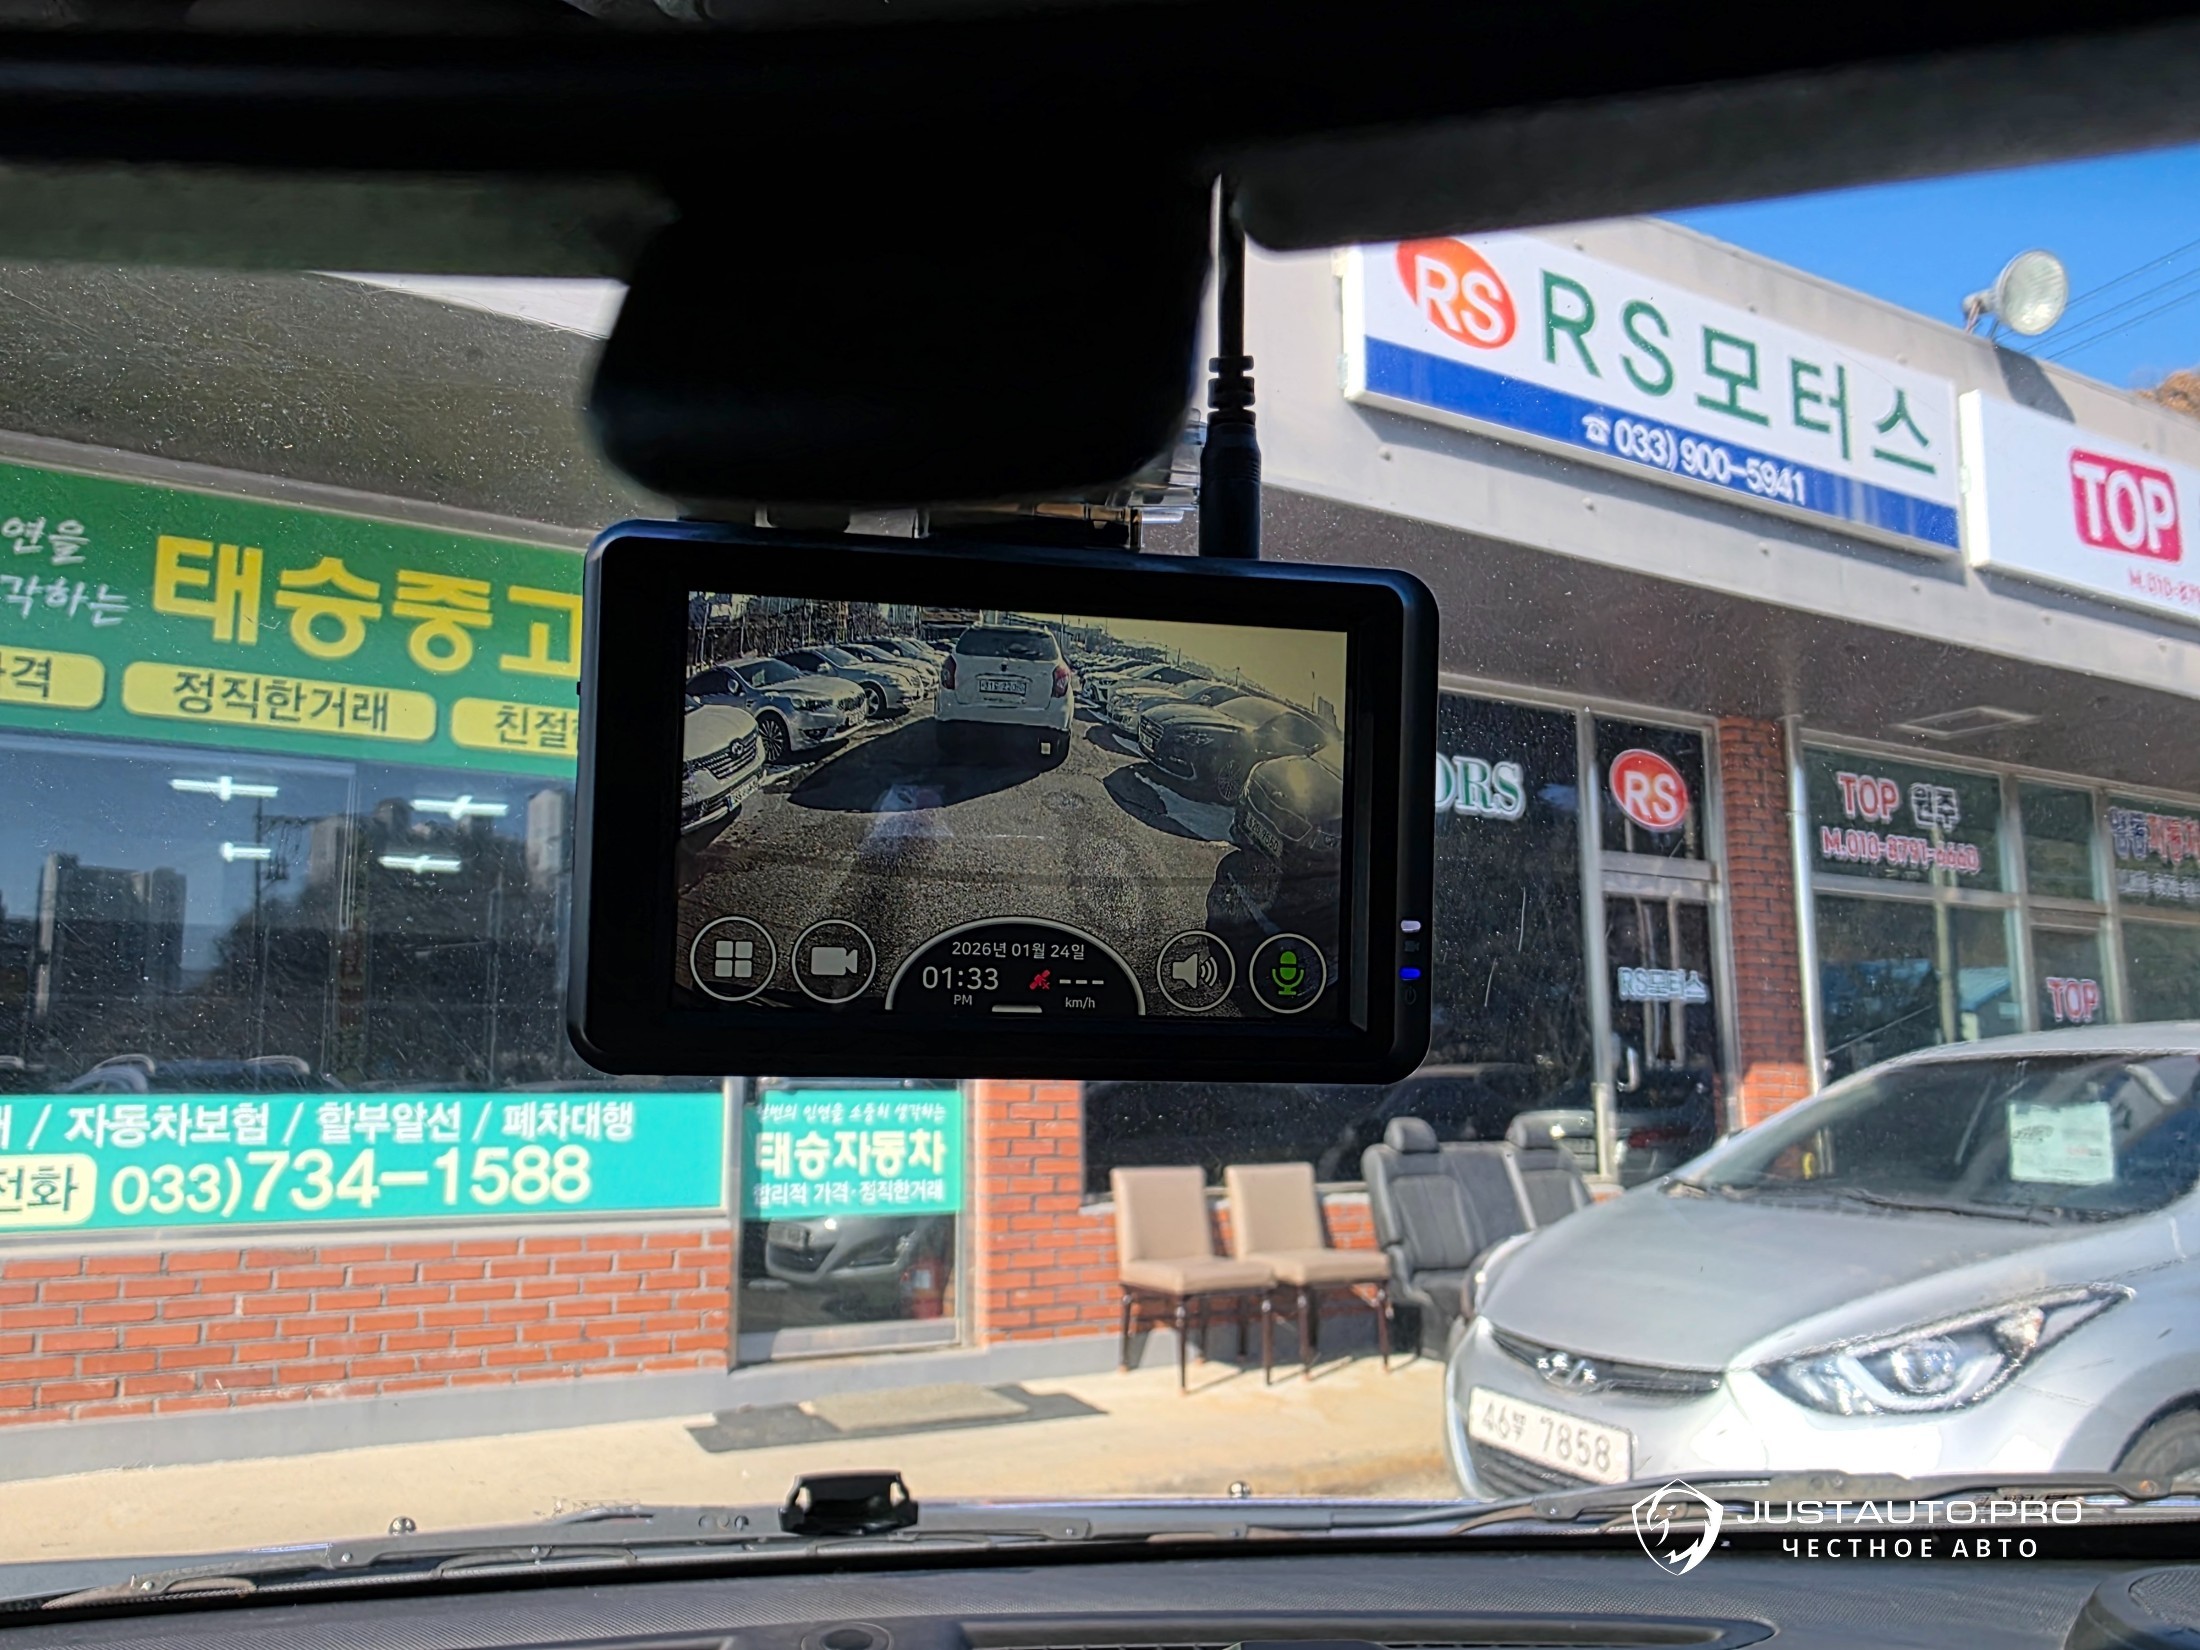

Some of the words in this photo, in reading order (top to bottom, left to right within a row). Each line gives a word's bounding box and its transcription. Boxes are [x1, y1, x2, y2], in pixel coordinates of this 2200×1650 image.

[1413, 253, 1507, 344] RS
[2071, 460, 2177, 555] TOP
[153, 534, 583, 680] 태승중고
[173, 671, 390, 732] 정직한거래
[495, 704, 578, 750] 친절
[1622, 769, 1678, 822] RS
[1836, 771, 1900, 824] TOP
[952, 941, 1007, 958] 2026년
[1011, 943, 1046, 960] 01월
[1050, 944, 1085, 961] 24일
[922, 966, 999, 990] 01:33
[953, 994, 973, 1006] PM
[1065, 997, 1096, 1009] km/h
[2045, 976, 2099, 1023] TOP
[64, 1102, 269, 1148] 자동차보험
[317, 1101, 461, 1145] 할부알선
[501, 1100, 634, 1142] 폐차대행
[757, 1129, 947, 1178] 태승자동차
[1540, 1413, 1612, 1473] 7858
